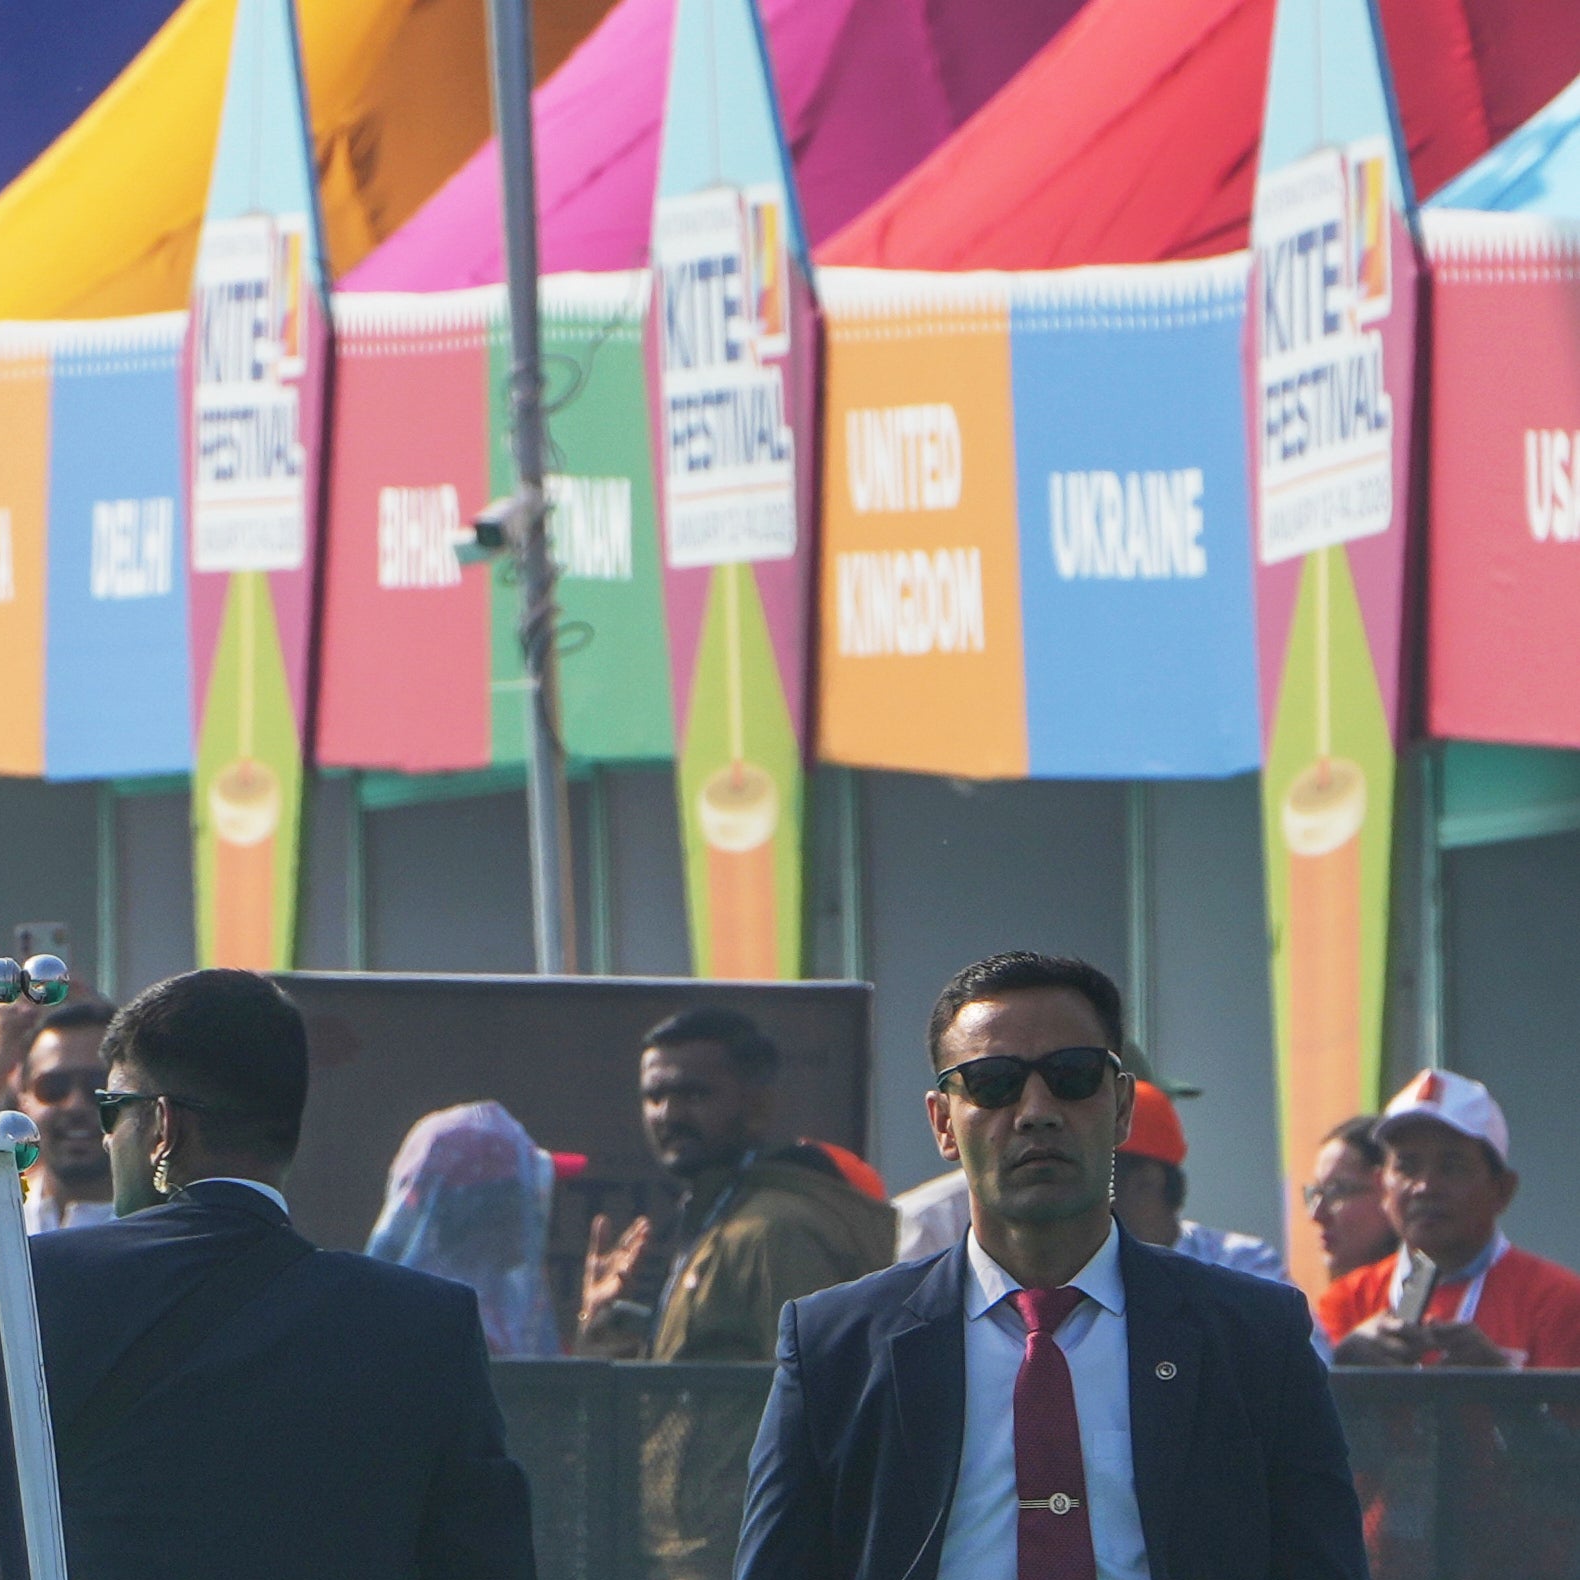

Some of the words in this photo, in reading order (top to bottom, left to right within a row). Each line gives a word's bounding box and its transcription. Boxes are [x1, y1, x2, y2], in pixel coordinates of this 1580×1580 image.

[201, 279, 268, 384] KITE
[665, 252, 740, 370] KITE
[1264, 220, 1340, 358] KITE
[201, 402, 299, 482] FESTIVAL
[671, 382, 791, 472] FESTIVAL
[845, 403, 962, 515] UNITED
[1265, 341, 1389, 470] FESTIVAL
[377, 483, 463, 589] BIHAR
[1049, 468, 1207, 581] UKRAINE
[1524, 427, 1580, 542] US
[91, 497, 174, 600] DELHI
[836, 546, 985, 657] KINGDOM
